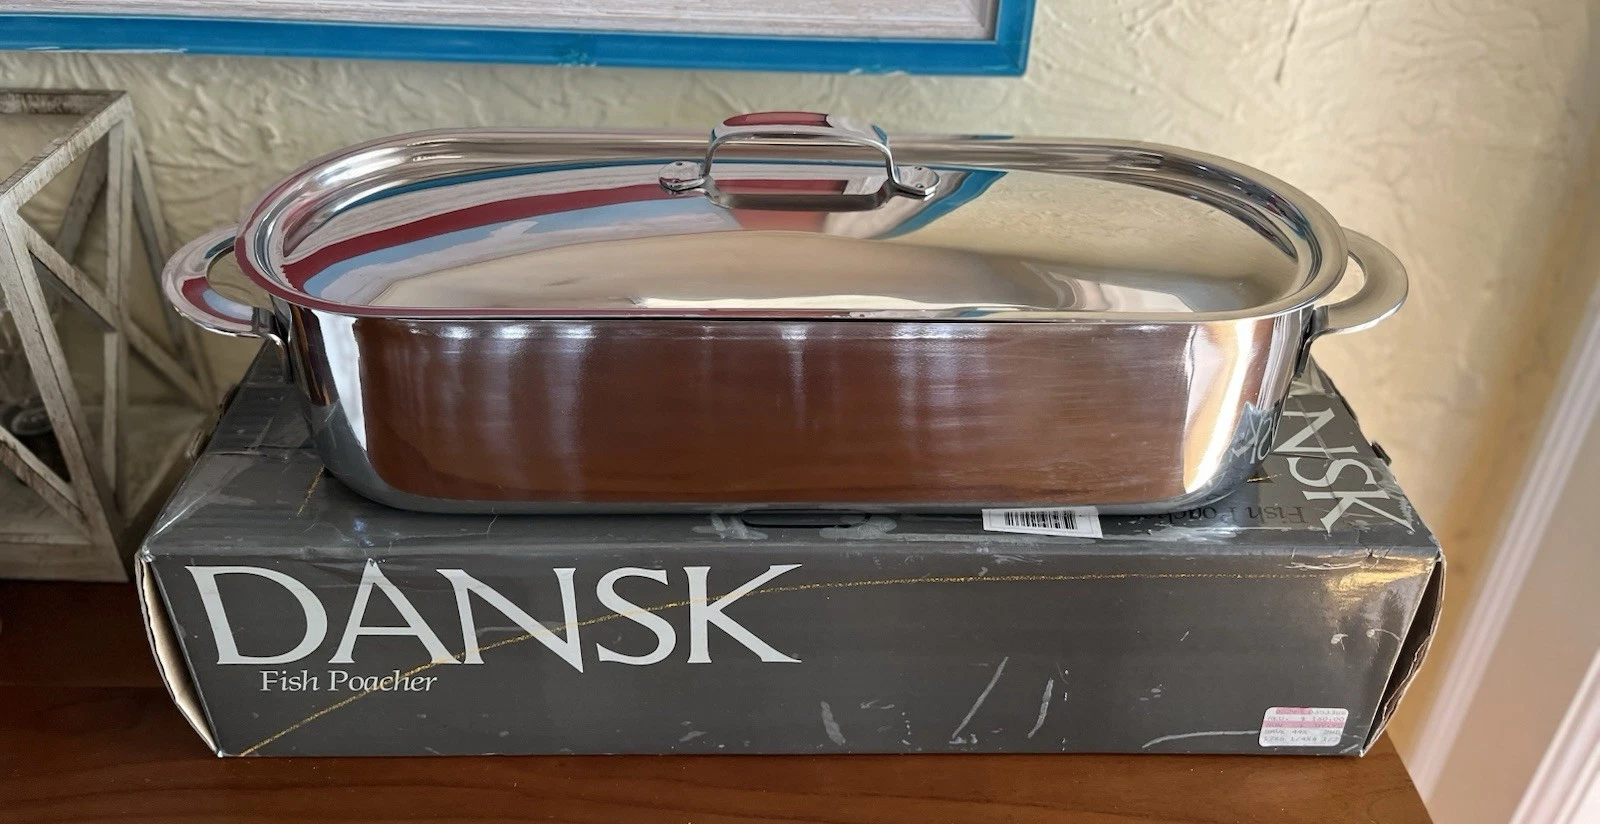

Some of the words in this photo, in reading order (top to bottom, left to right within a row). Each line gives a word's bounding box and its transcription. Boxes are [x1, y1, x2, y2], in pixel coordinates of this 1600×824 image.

[1272, 380, 1416, 534] NSK
[1247, 506, 1309, 525] Fish
[184, 558, 802, 673] DANSK
[259, 669, 320, 692] Fish
[327, 669, 438, 692] Poacher
